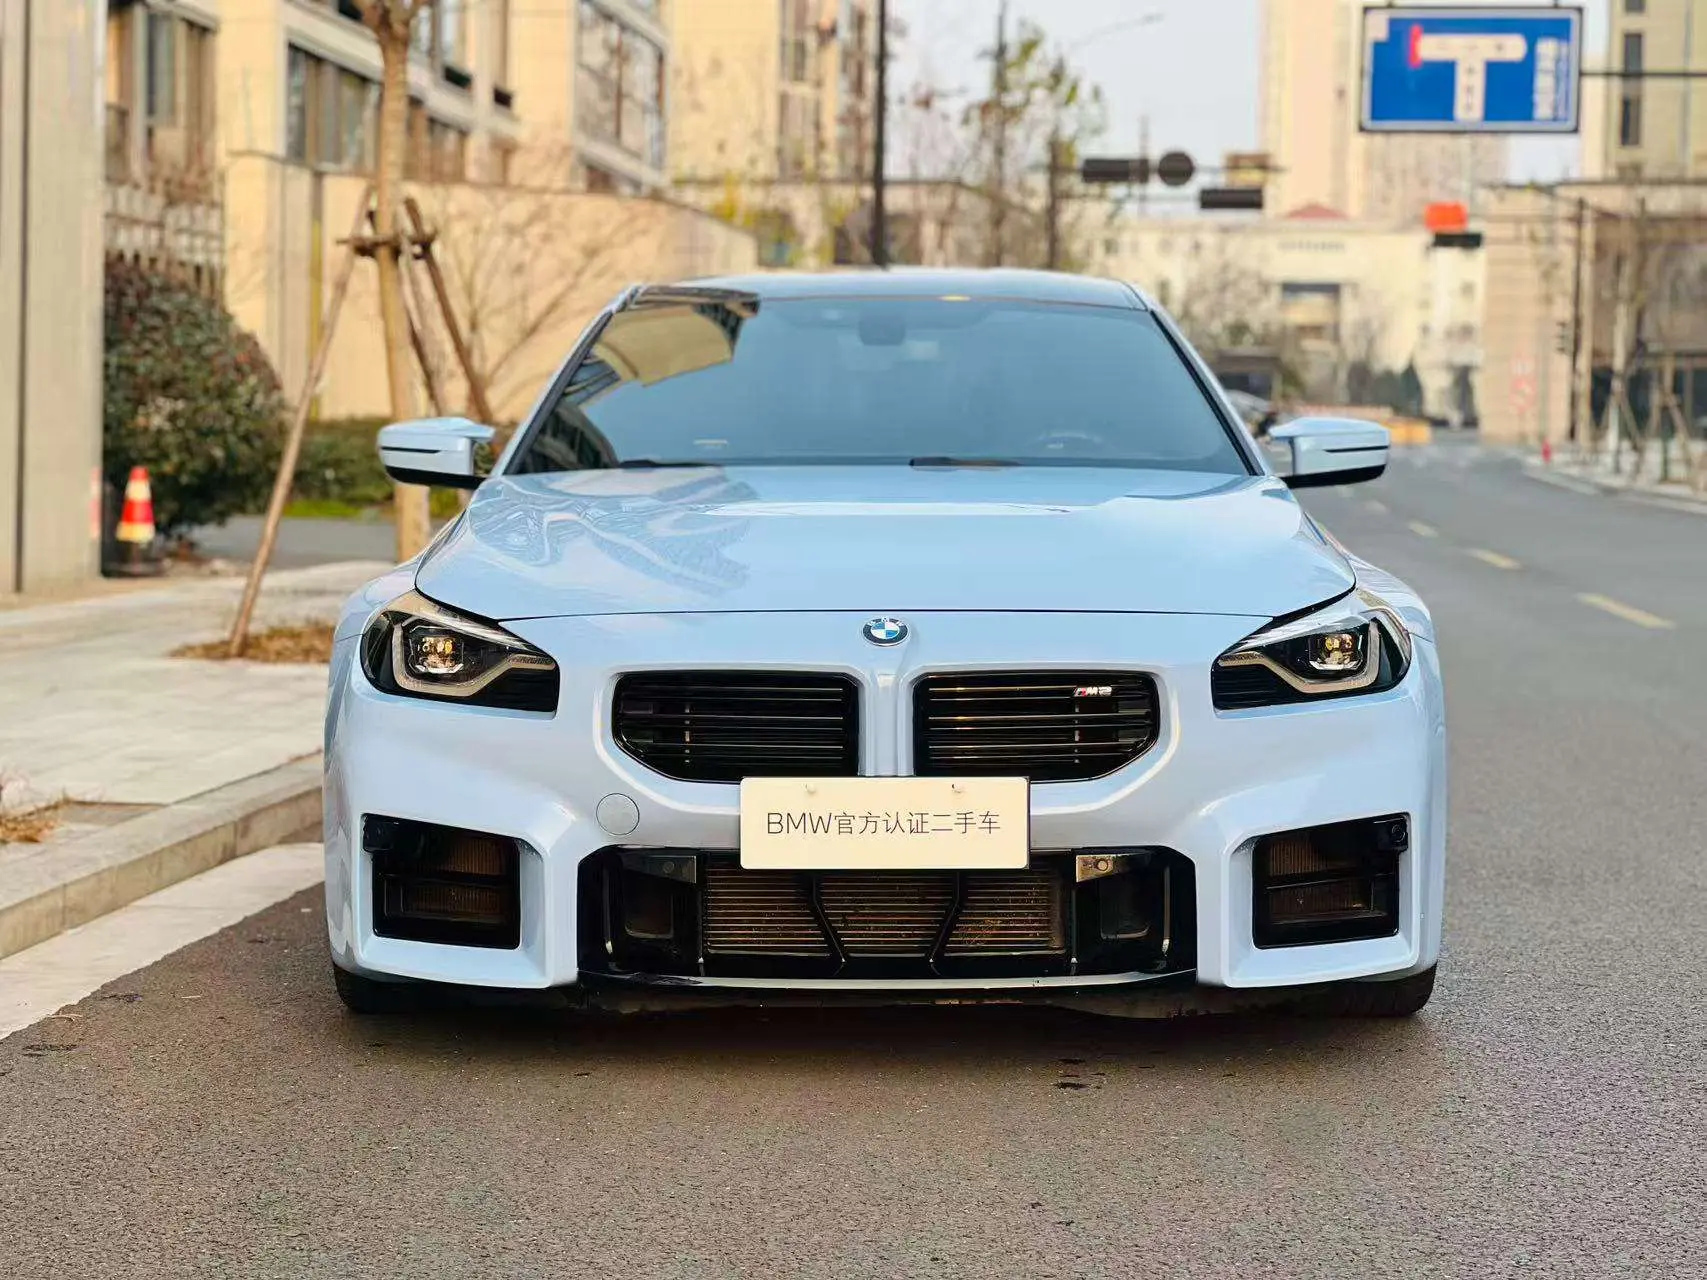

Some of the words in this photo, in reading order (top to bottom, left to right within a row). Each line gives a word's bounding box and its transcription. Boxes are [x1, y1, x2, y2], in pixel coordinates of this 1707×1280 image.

[766, 810, 1001, 836] BMW官方认证二手车
